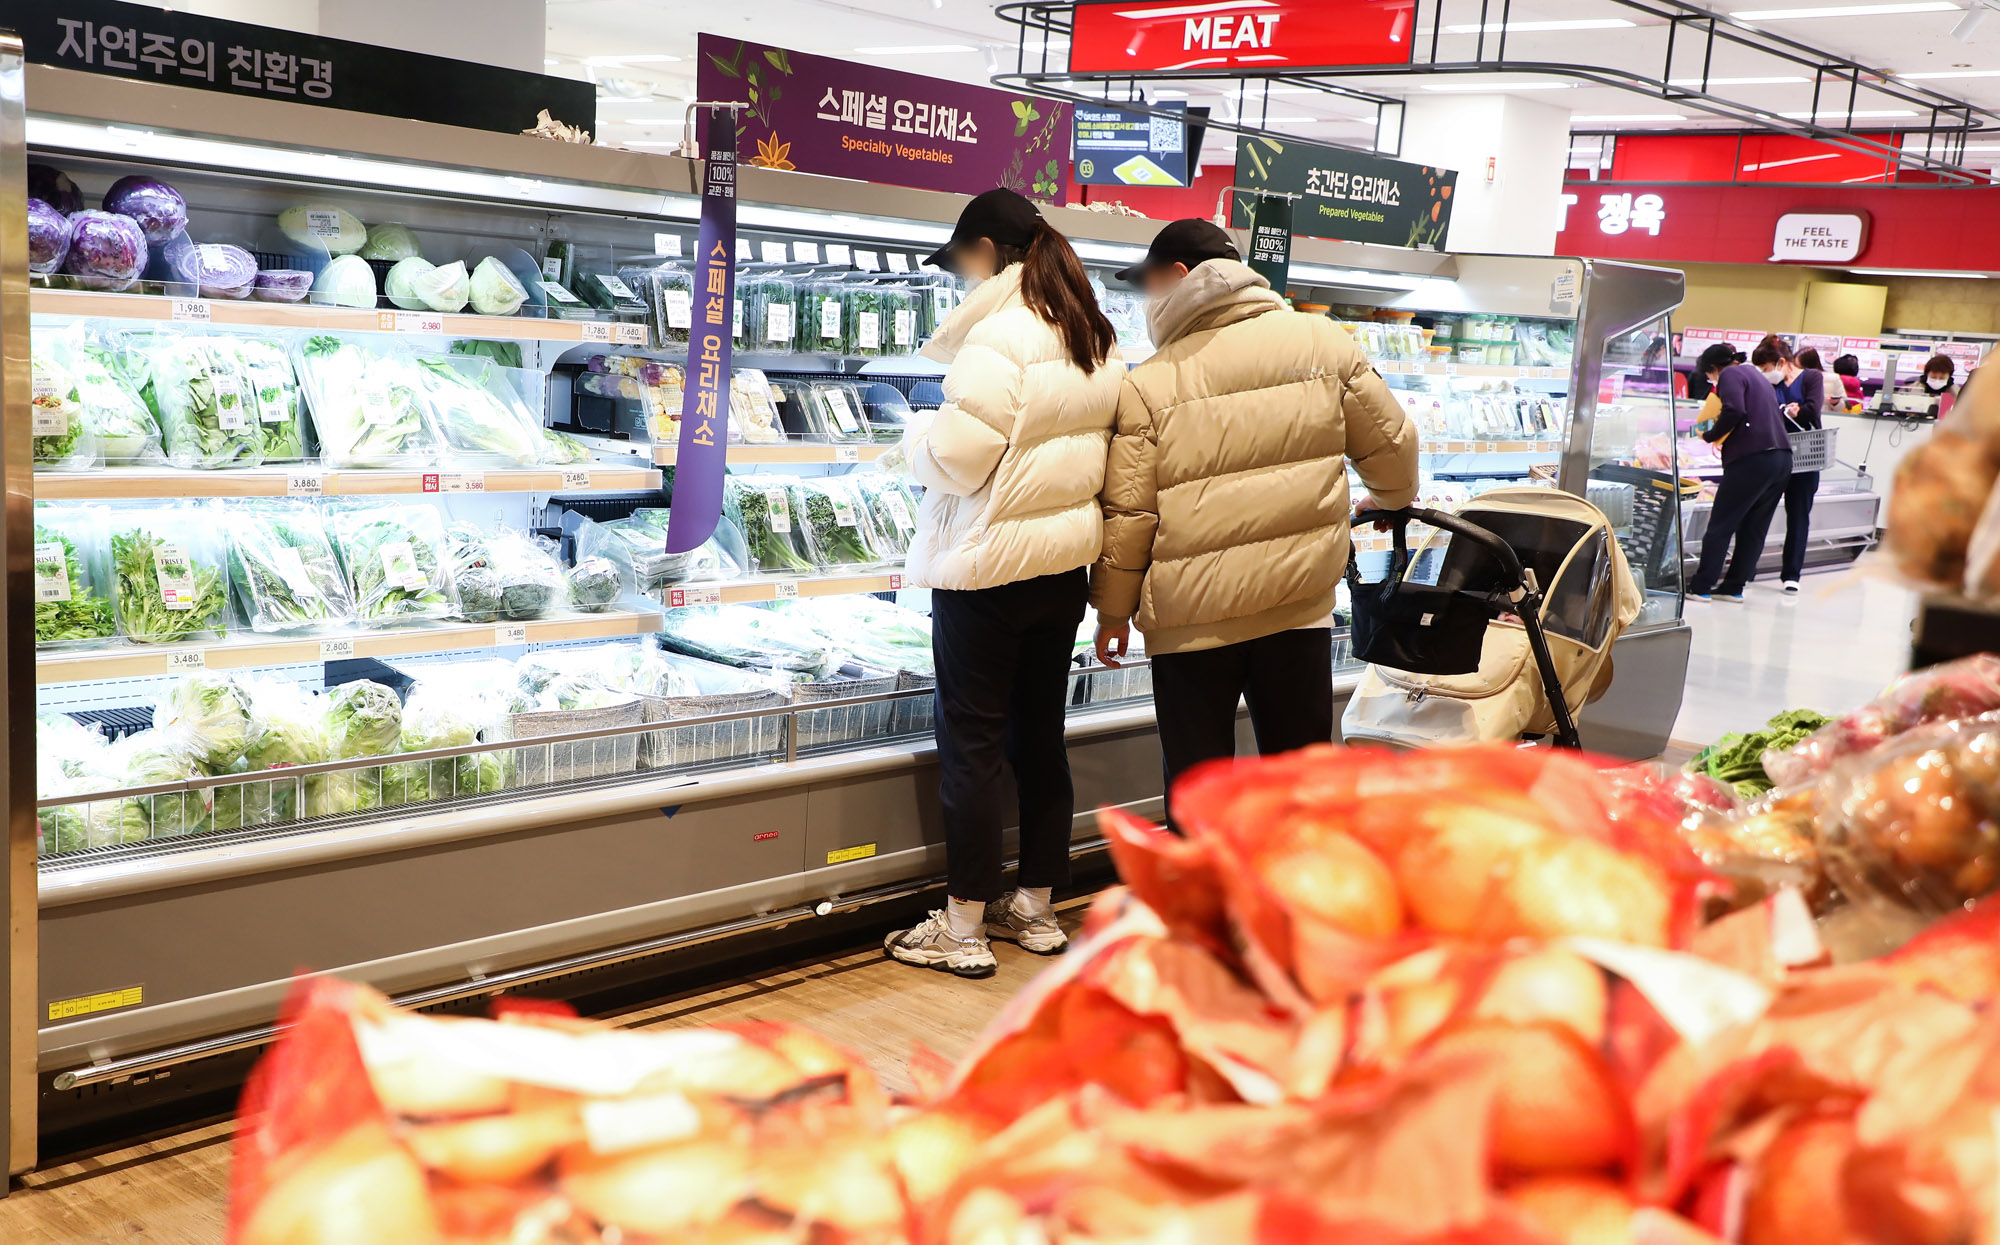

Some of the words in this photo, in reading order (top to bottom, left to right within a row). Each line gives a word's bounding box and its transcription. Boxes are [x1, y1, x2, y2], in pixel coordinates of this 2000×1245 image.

[1183, 14, 1280, 51] MEAT
[56, 17, 215, 82] 자연주의
[227, 45, 333, 99] 친환경
[816, 87, 888, 131] 스페셜
[891, 99, 978, 144] 요리채소
[841, 135, 893, 158] Specialty
[895, 143, 953, 164] Vegetables
[712, 166, 733, 182] 100%
[1305, 167, 1349, 199] 초간단
[1349, 175, 1401, 206] 요리채소
[1319, 204, 1349, 218] Prepared
[1350, 208, 1384, 223] Vegetables
[1597, 193, 1666, 236] 정육
[1803, 227, 1833, 237] FEEL
[1259, 237, 1284, 251] 100%
[1784, 238, 1808, 248] THE
[1812, 239, 1849, 249] TASTE
[706, 240, 727, 325] 스페셜
[180, 303, 204, 313] 1,980
[421, 321, 441, 331] 2,980
[587, 326, 606, 336] 1,780
[621, 326, 640, 337] 1,680
[693, 335, 723, 446] 요리채소
[293, 479, 317, 489] 3,880
[465, 482, 484, 491] 3,580
[507, 629, 525, 638] 3,480
[326, 642, 348, 652] 2,800
[174, 653, 199, 664] 3,480
